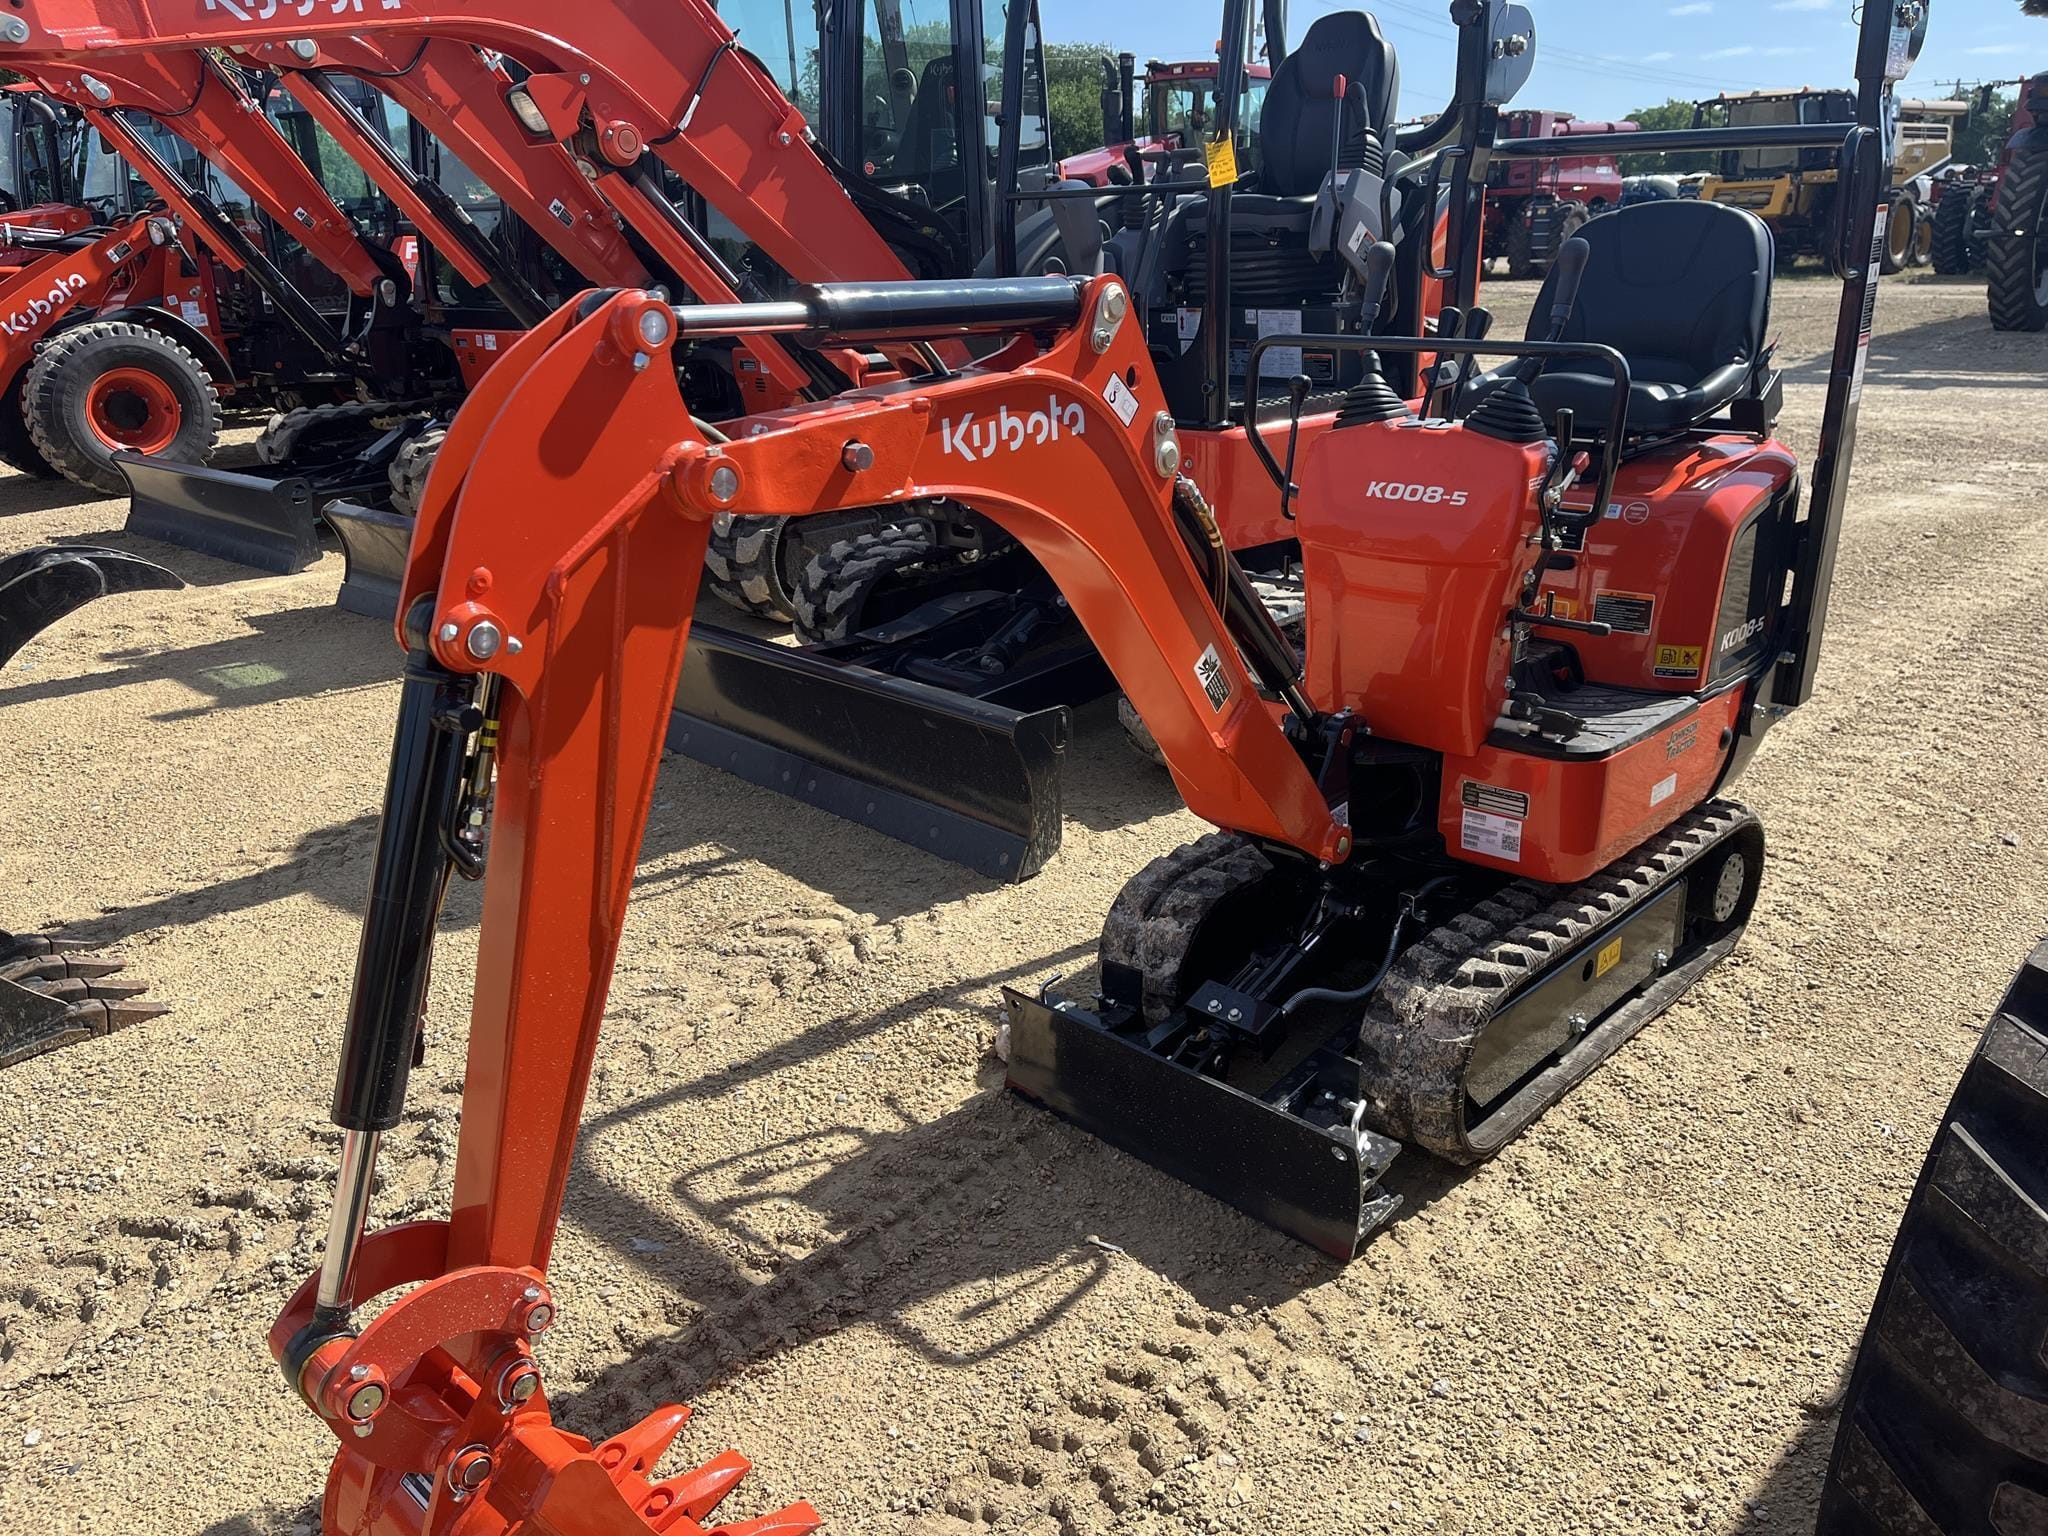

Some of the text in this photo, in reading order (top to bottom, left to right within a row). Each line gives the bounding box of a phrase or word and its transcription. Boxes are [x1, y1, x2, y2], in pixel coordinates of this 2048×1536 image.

[0, 273, 87, 336] Kubota
[942, 394, 1085, 462] Kubota
[1366, 481, 1468, 506] K008-5
[1720, 616, 1765, 652] K008-5
